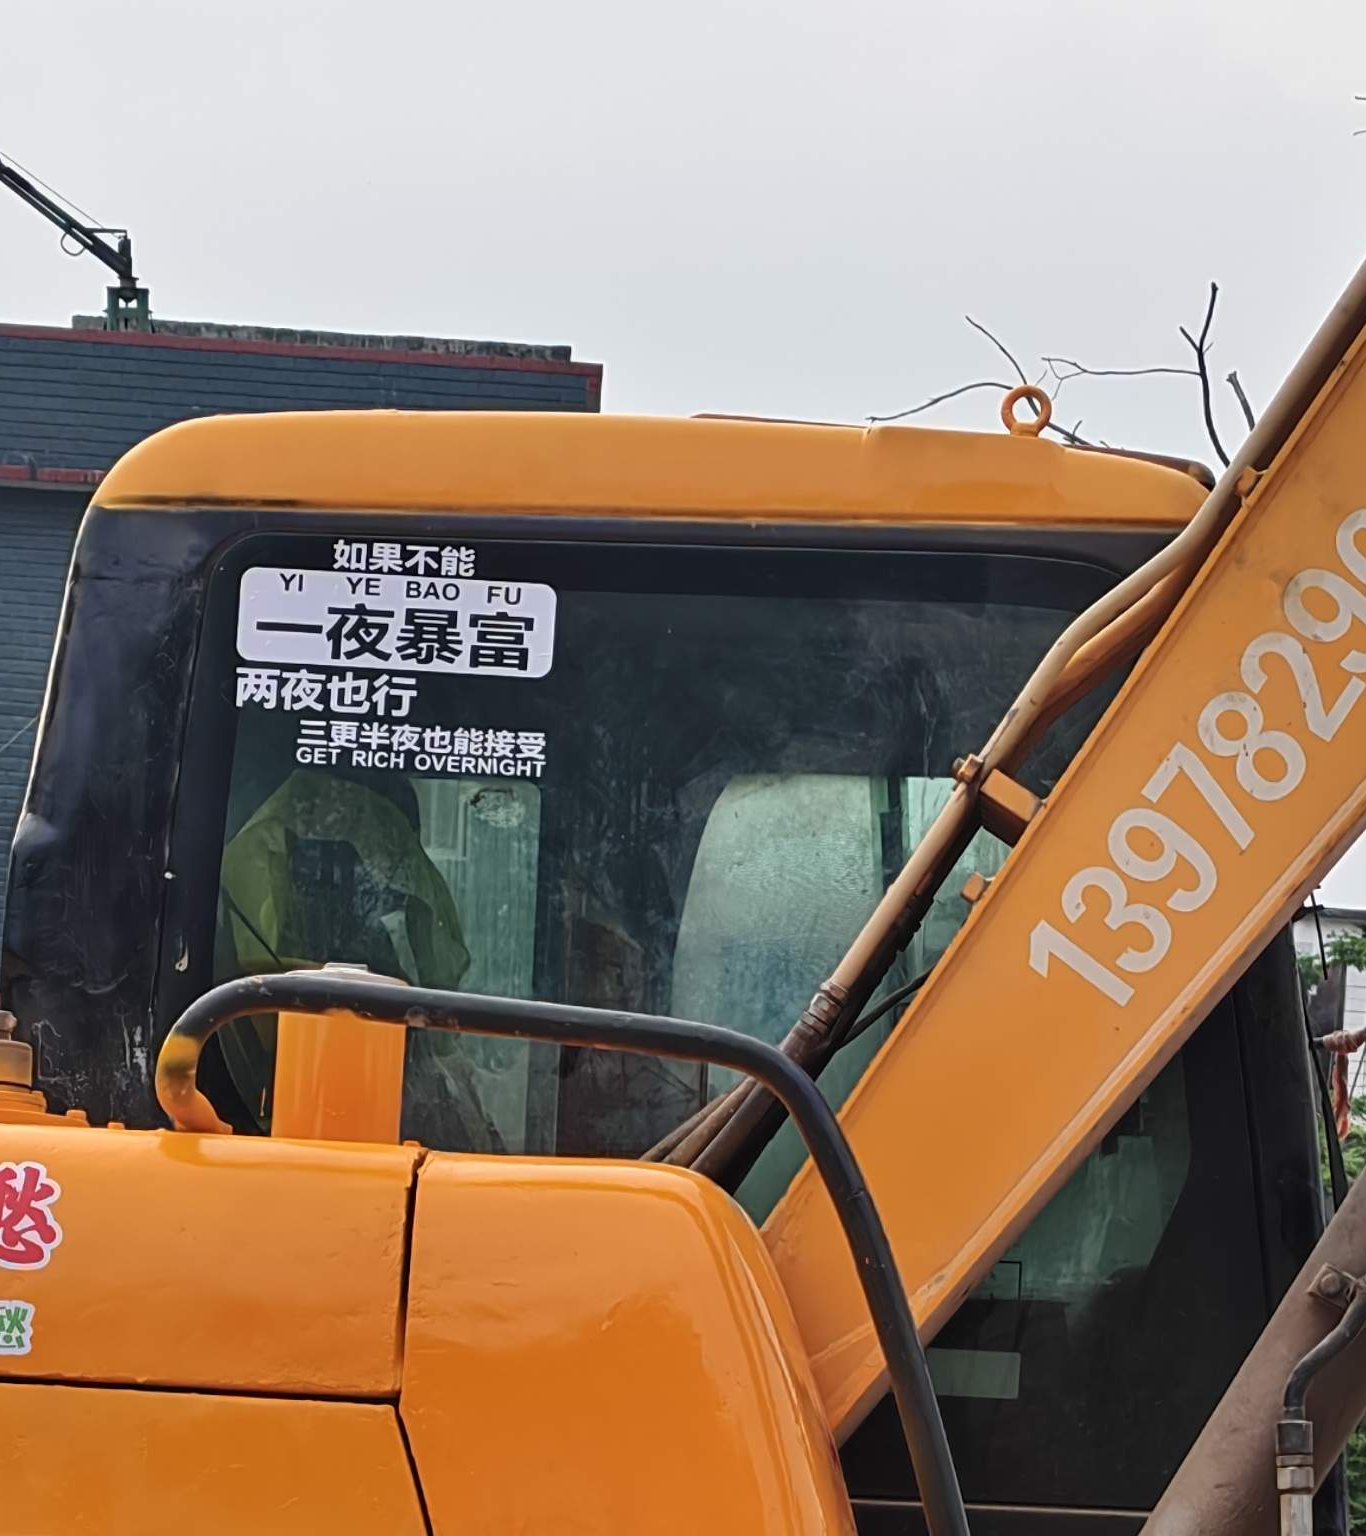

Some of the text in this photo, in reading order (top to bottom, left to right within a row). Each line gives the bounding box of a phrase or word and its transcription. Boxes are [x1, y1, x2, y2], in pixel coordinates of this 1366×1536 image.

[332, 539, 476, 577] 如果不能
[279, 573, 522, 605] YI YE BAO FU
[256, 603, 534, 671] 一夜暴富
[235, 666, 418, 717] 两夜也行
[297, 719, 547, 760] 三更半夜也能接受
[296, 747, 547, 777] GET RICH OVERNIGHT
